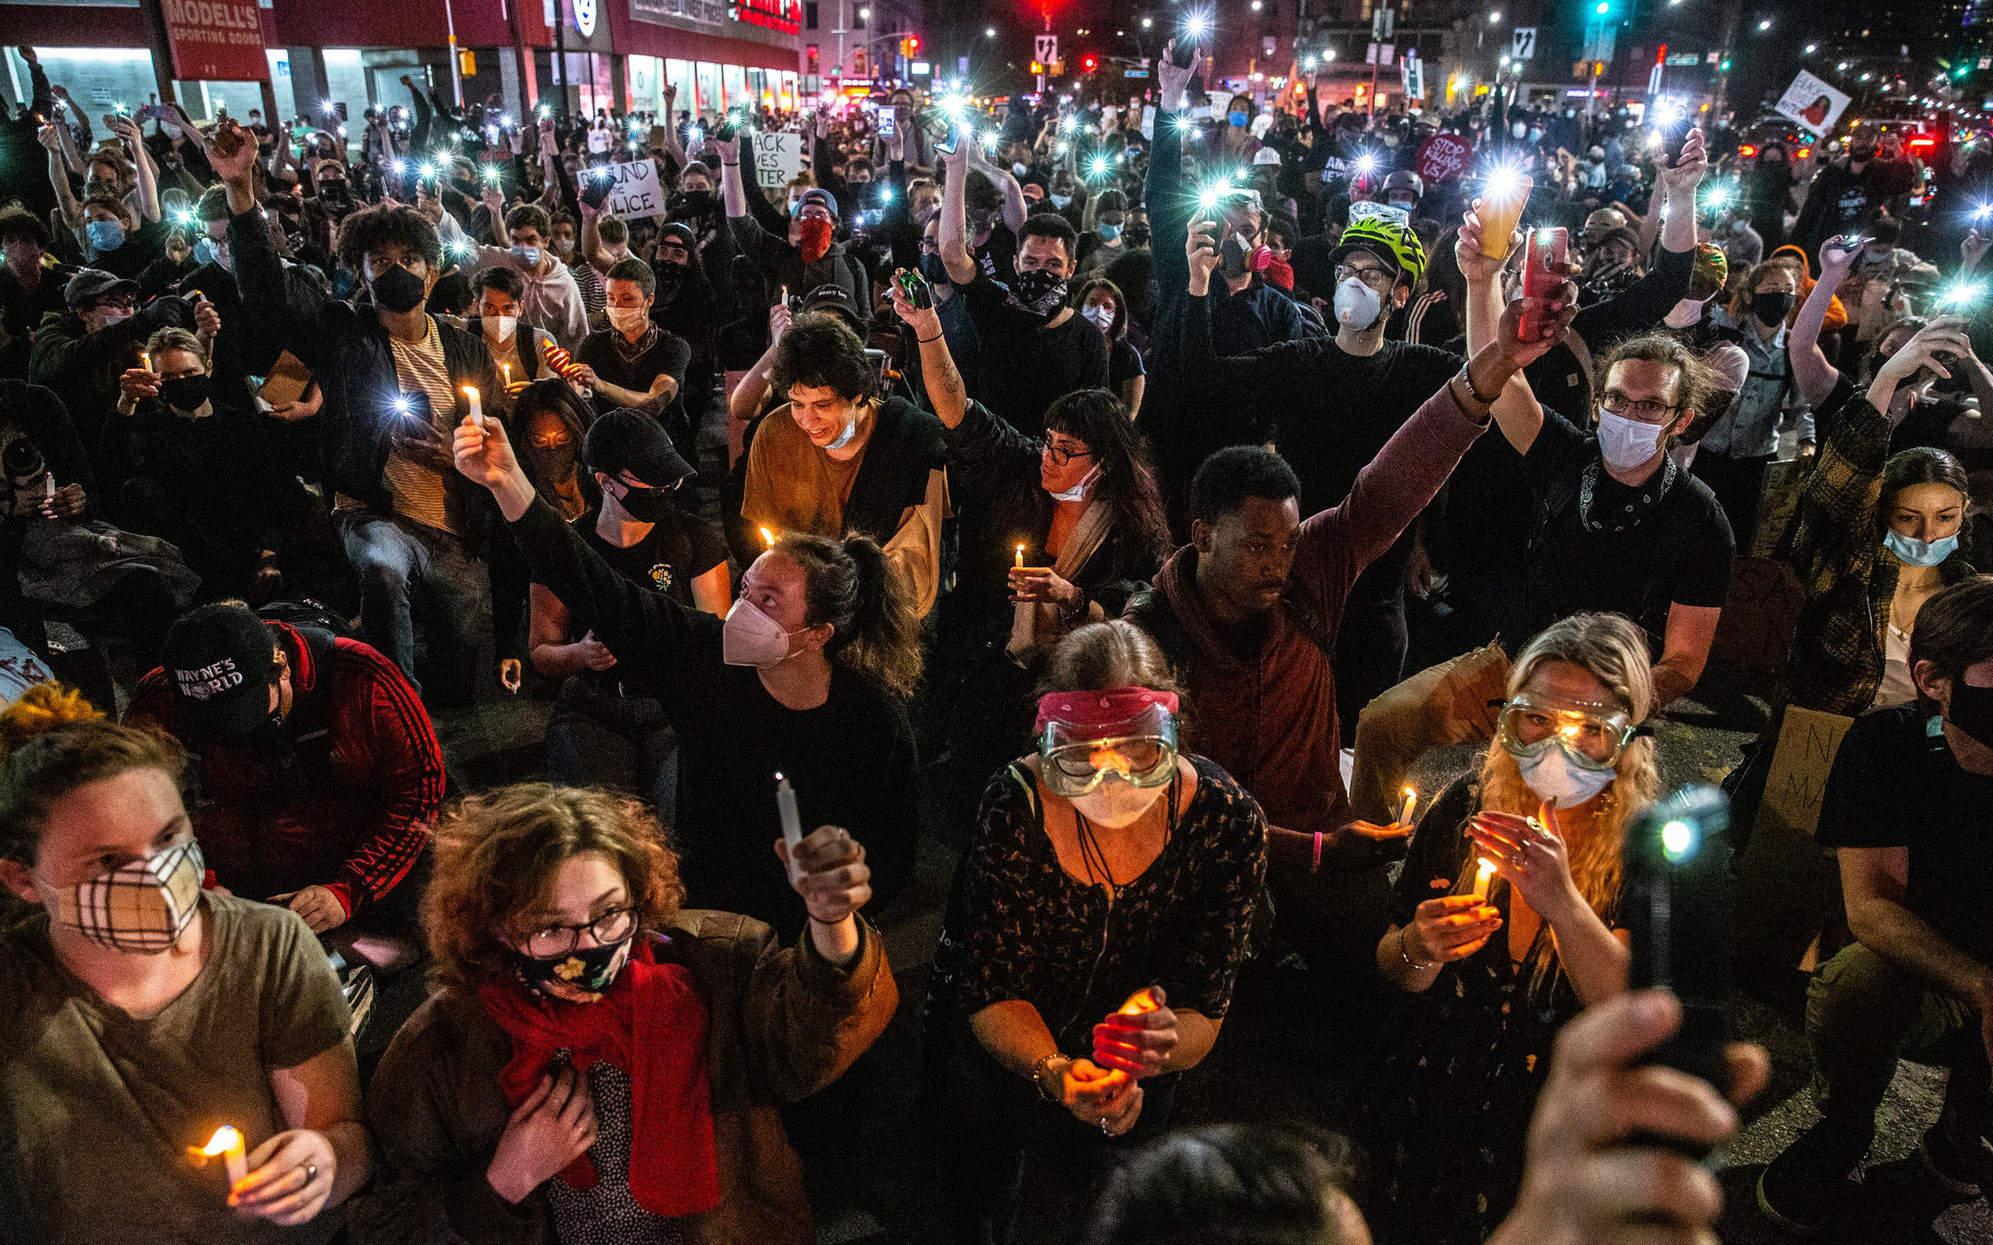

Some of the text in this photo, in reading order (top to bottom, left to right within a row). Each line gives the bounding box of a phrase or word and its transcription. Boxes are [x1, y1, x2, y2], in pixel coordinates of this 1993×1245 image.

[166, 0, 258, 29] MODELL'S
[173, 27, 262, 45] SPORTING GOODS
[754, 134, 786, 153] ACK
[1432, 138, 1465, 158] STOP
[759, 168, 786, 185] TER
[611, 192, 655, 216] LICE
[175, 658, 236, 682] WAYNE'S
[179, 671, 243, 700] WORLD
